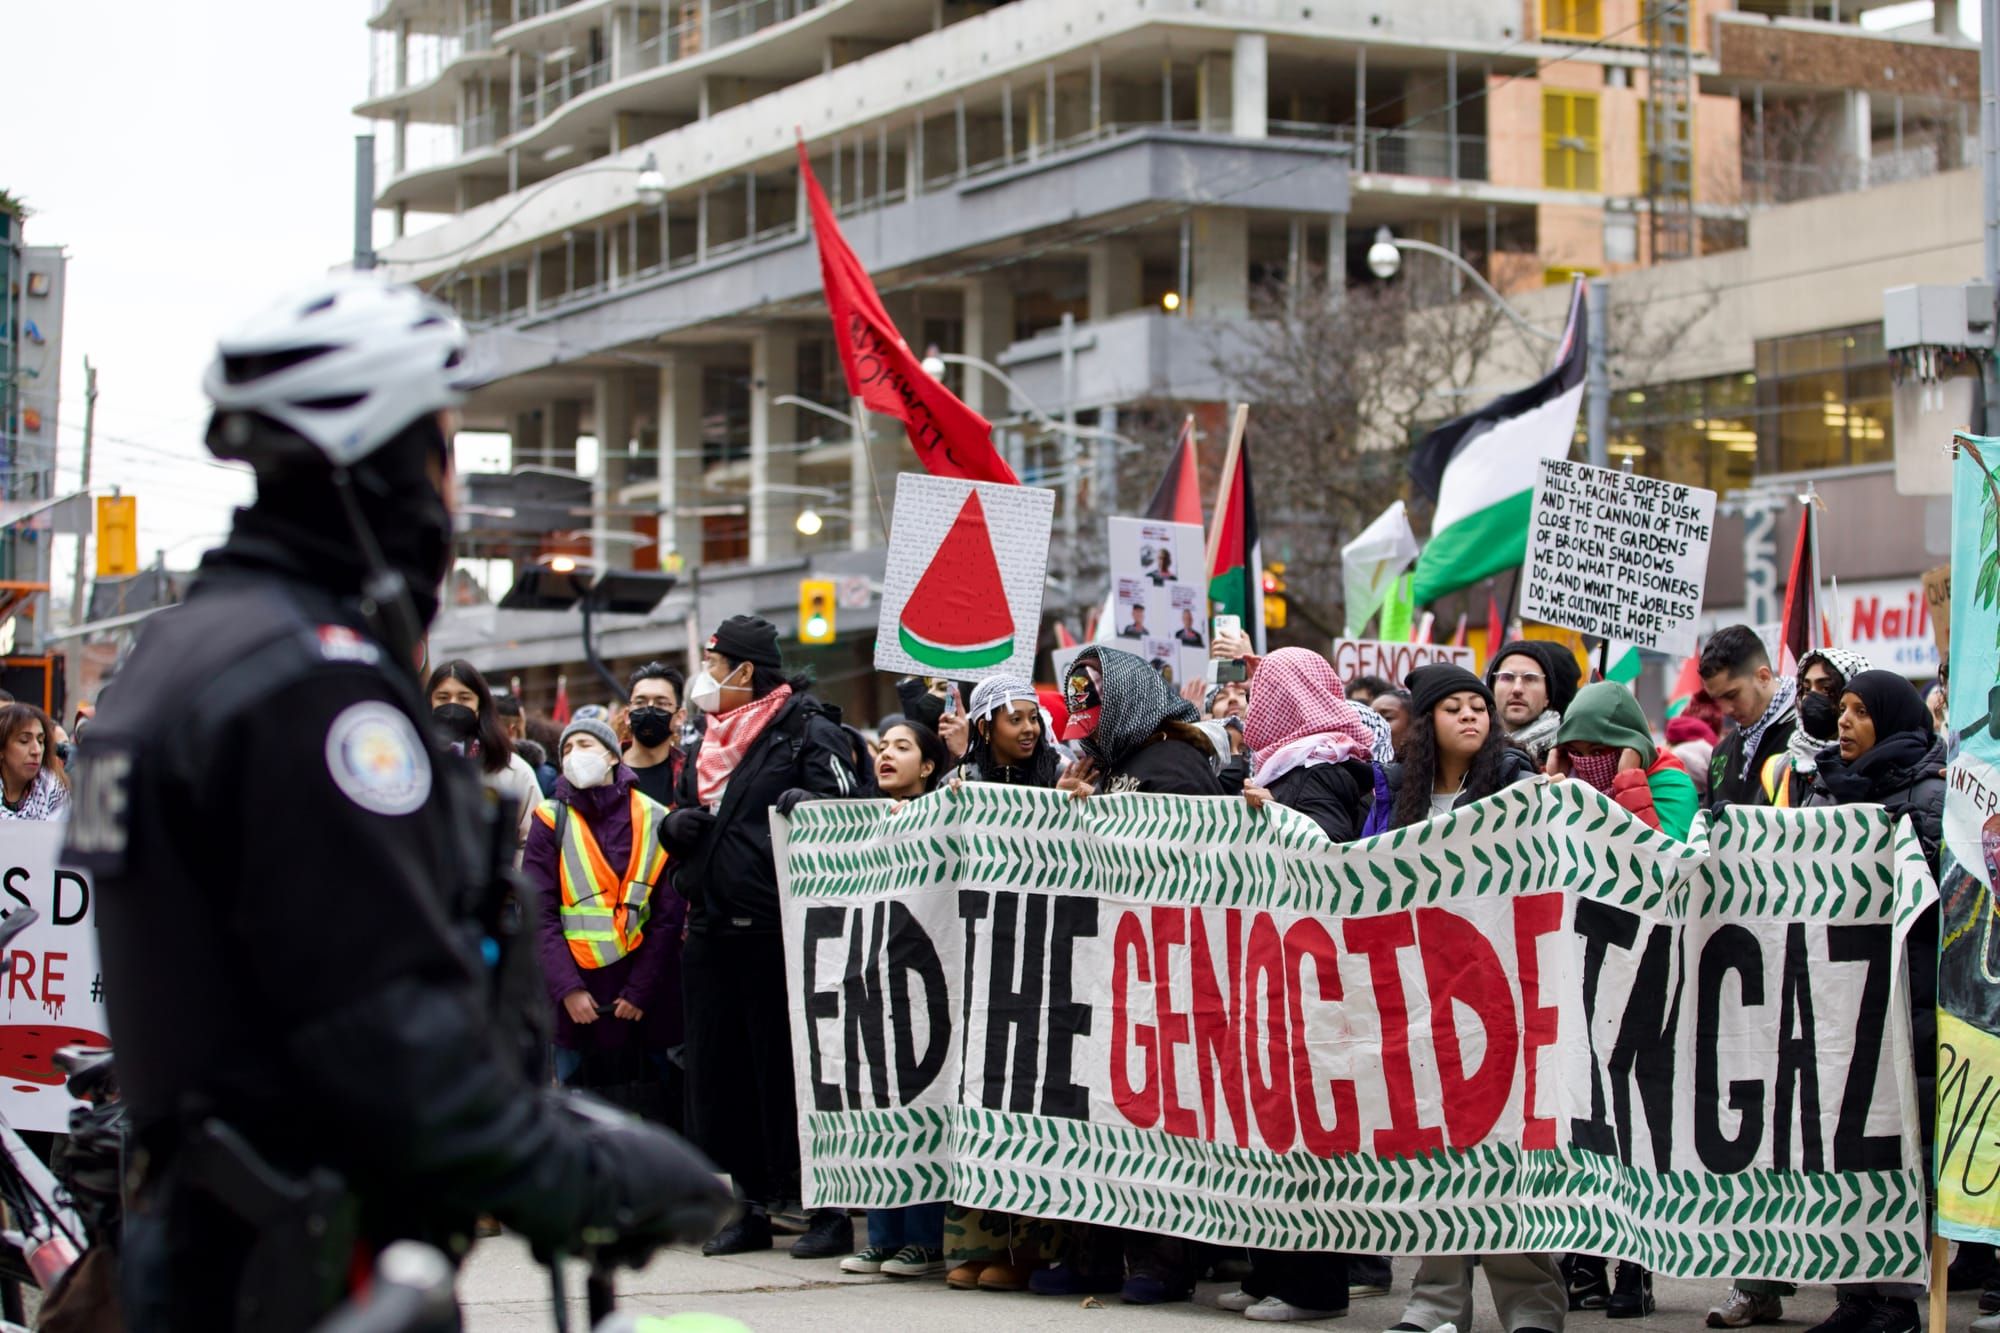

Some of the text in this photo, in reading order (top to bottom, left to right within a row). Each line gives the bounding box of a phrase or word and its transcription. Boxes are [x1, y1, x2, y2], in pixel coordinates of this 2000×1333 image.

[1578, 468, 1593, 481] ON
[1598, 470, 1619, 488] THE
[1625, 477, 1669, 499] SLOPES
[1673, 487, 1689, 503] OF
[1586, 485, 1627, 506] FACING
[1634, 495, 1655, 512] THE
[1661, 501, 1700, 520] DUSK
[1538, 512, 1688, 556] CLOSE TO THE GARDENS
[1540, 493, 1709, 542] AND THE CANNON OF TIME
[1537, 530, 1674, 573] OF BROKEN SHADOWS
[1535, 548, 1699, 600] WE DO WHAT PRISONERS
[1550, 590, 1564, 606] WE
[1568, 594, 1621, 621] CULTIVATE
[1555, 573, 1581, 590] AND
[1584, 578, 1614, 599] WHAT
[1617, 587, 1639, 606] THE
[1640, 594, 1695, 620] JOBLESS
[1602, 621, 1656, 647] DARWISH
[1951, 766, 1997, 816] INTER
[803, 900, 952, 1112] END
[958, 890, 1099, 1121] THE
[1110, 891, 1564, 1161] GENOCIDE
[1571, 895, 1686, 1174] IN
